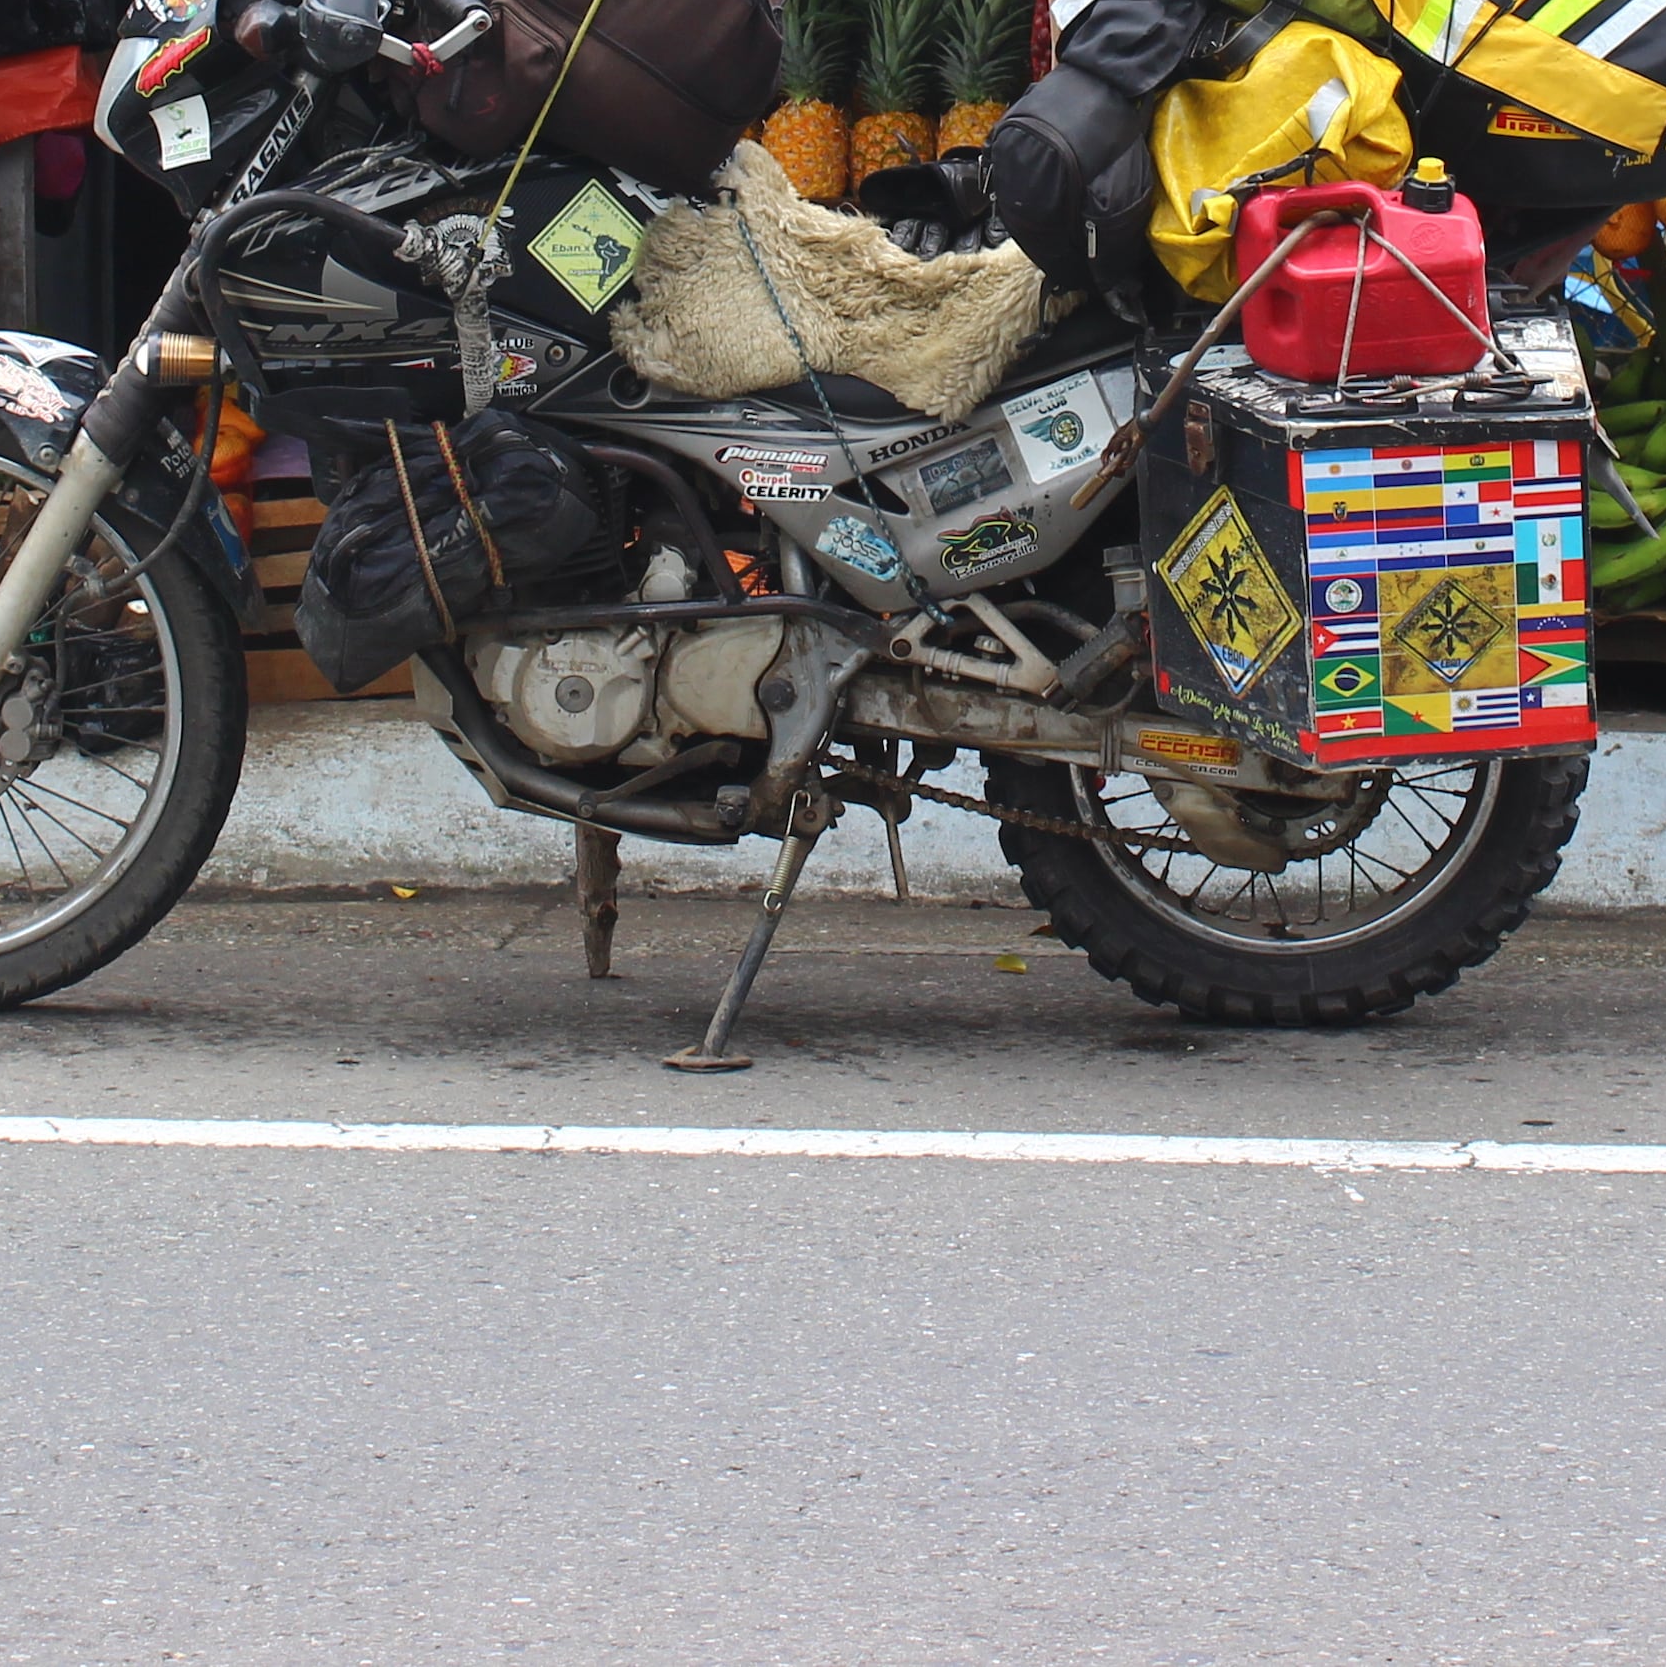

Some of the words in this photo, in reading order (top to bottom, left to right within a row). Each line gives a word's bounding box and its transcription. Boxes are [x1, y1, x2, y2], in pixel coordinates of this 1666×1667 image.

[1496, 111, 1579, 134] PIREL
[496, 337, 534, 350] CLUB
[867, 422, 972, 464] HONDA
[756, 473, 790, 485] terpel
[746, 485, 830, 502] CELERITY
[1221, 645, 1246, 668] EBAN
